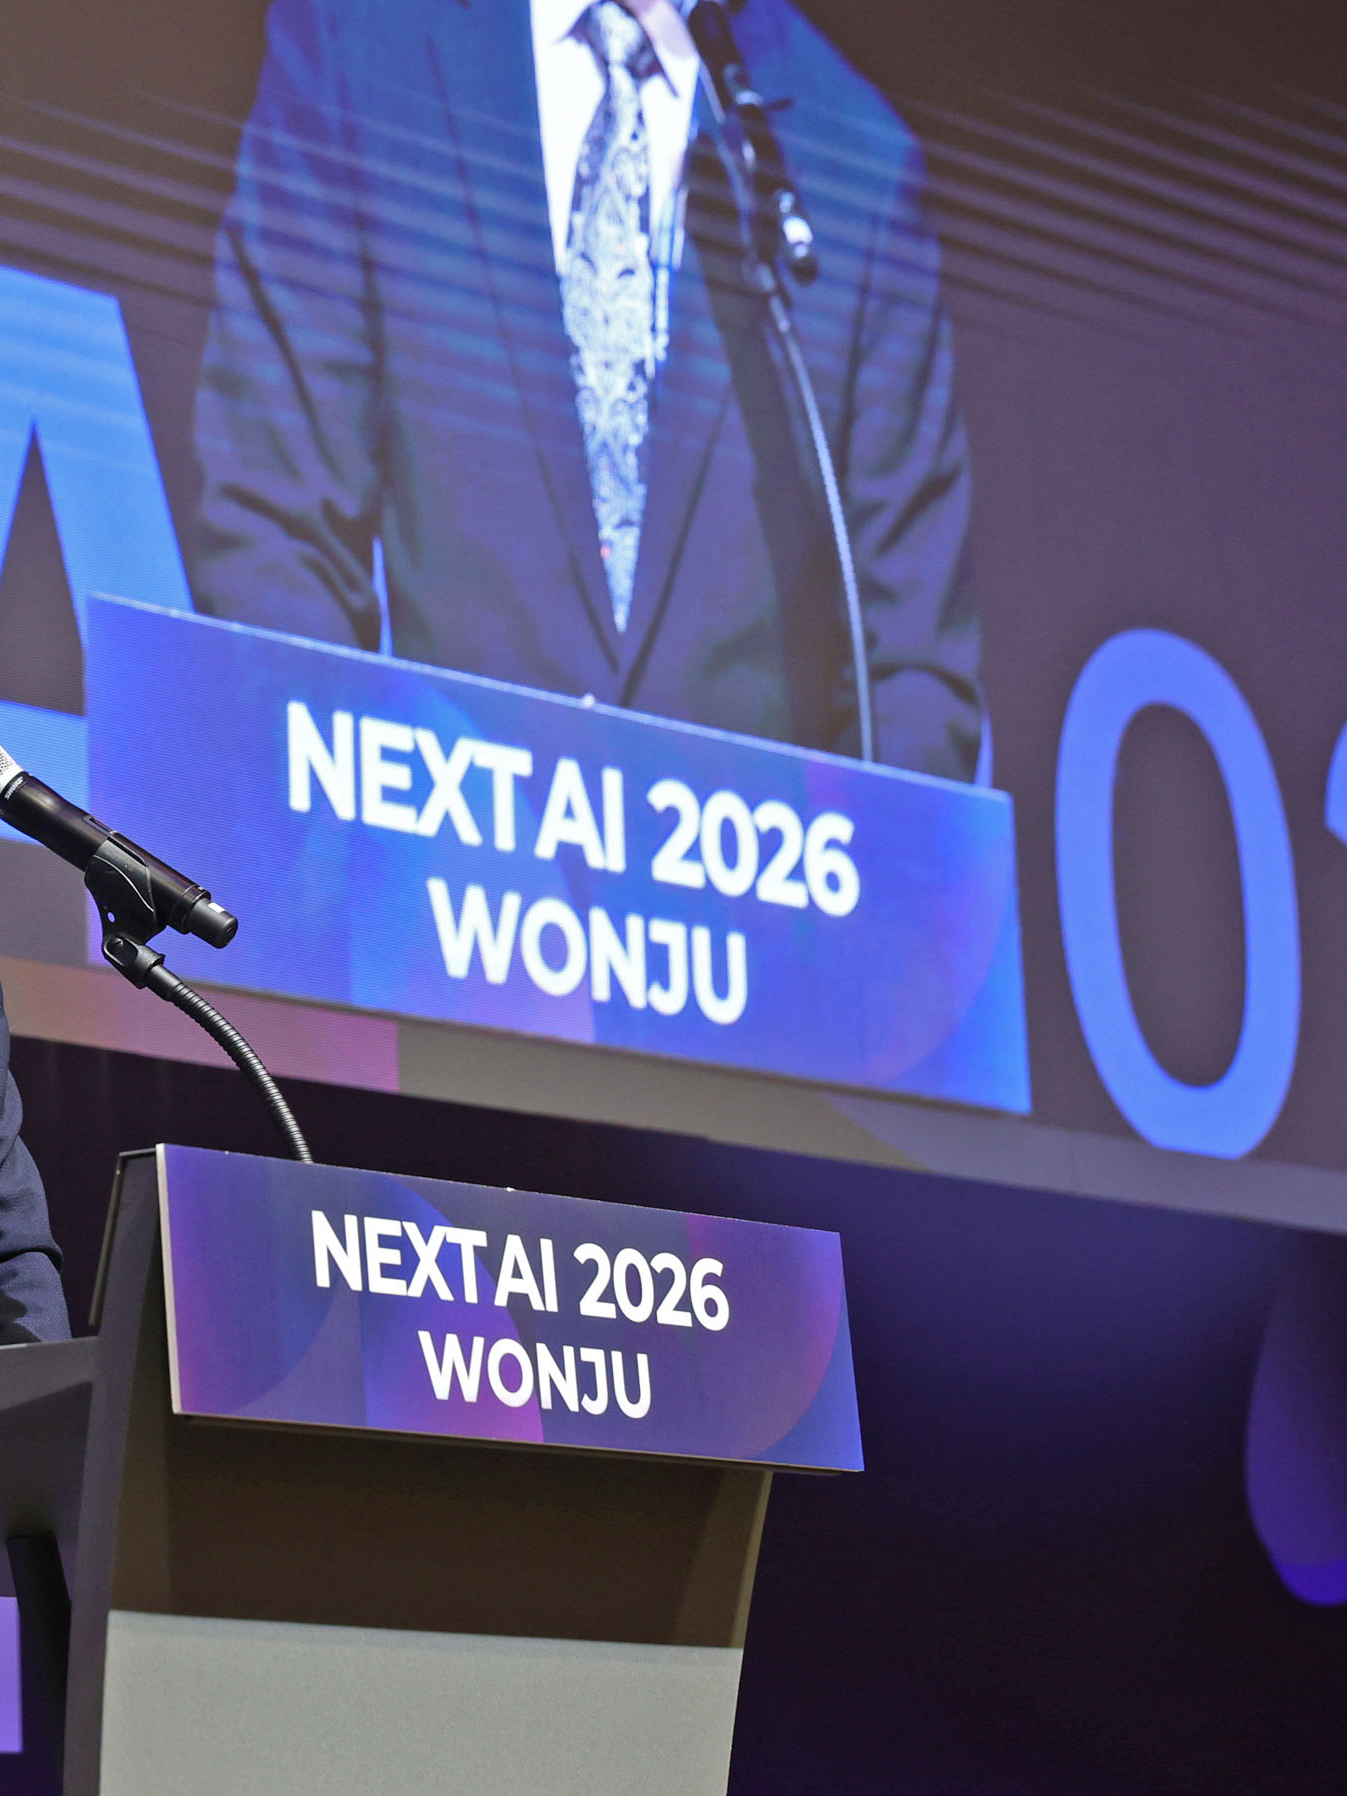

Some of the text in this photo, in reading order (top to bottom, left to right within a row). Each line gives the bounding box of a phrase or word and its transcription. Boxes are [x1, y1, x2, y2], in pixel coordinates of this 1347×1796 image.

[286, 699, 861, 917] NEXT AI 2026
[425, 876, 749, 1026] WONJU
[310, 1210, 731, 1332] NEXT AI 2026
[417, 1330, 652, 1419] WONJU
